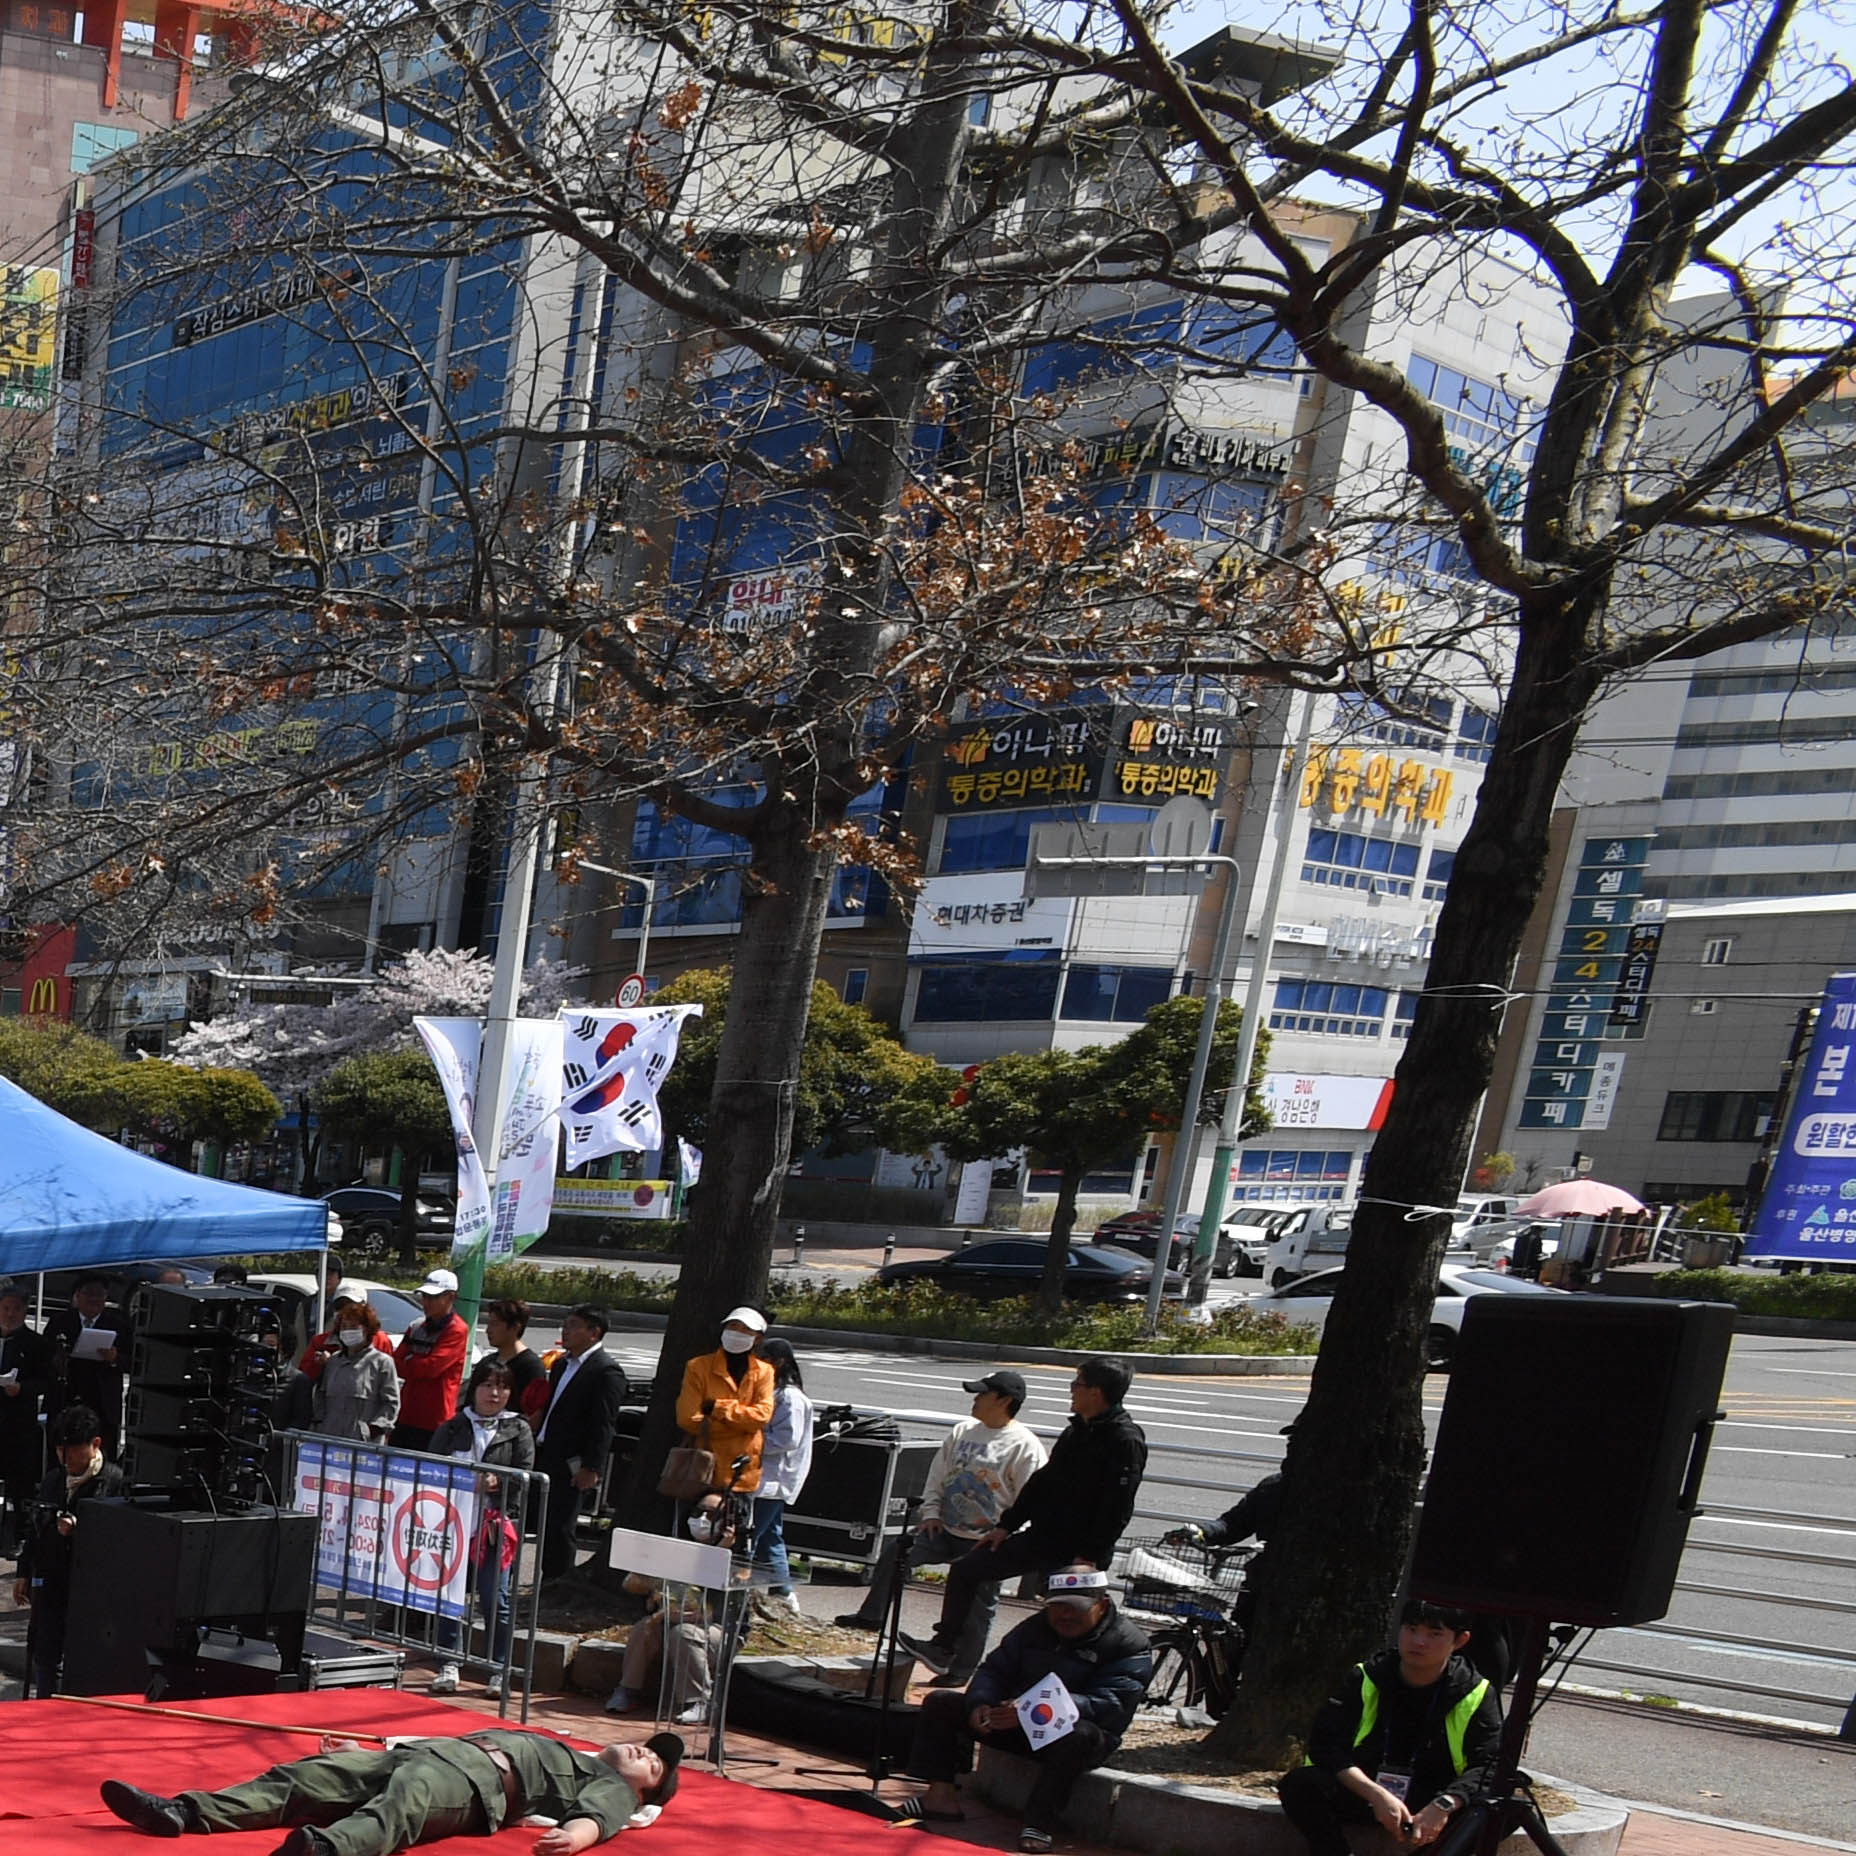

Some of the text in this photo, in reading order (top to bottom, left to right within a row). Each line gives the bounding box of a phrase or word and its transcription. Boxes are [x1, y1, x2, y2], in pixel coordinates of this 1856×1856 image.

[946, 761, 1088, 805] 통증의학과
[1116, 759, 1218, 801] 통증의학과
[937, 901, 1026, 926] 현대차증권
[621, 986, 638, 1001] 60
[1294, 1079, 1316, 1095] BNK
[1280, 1098, 1321, 1124] 경남은행
